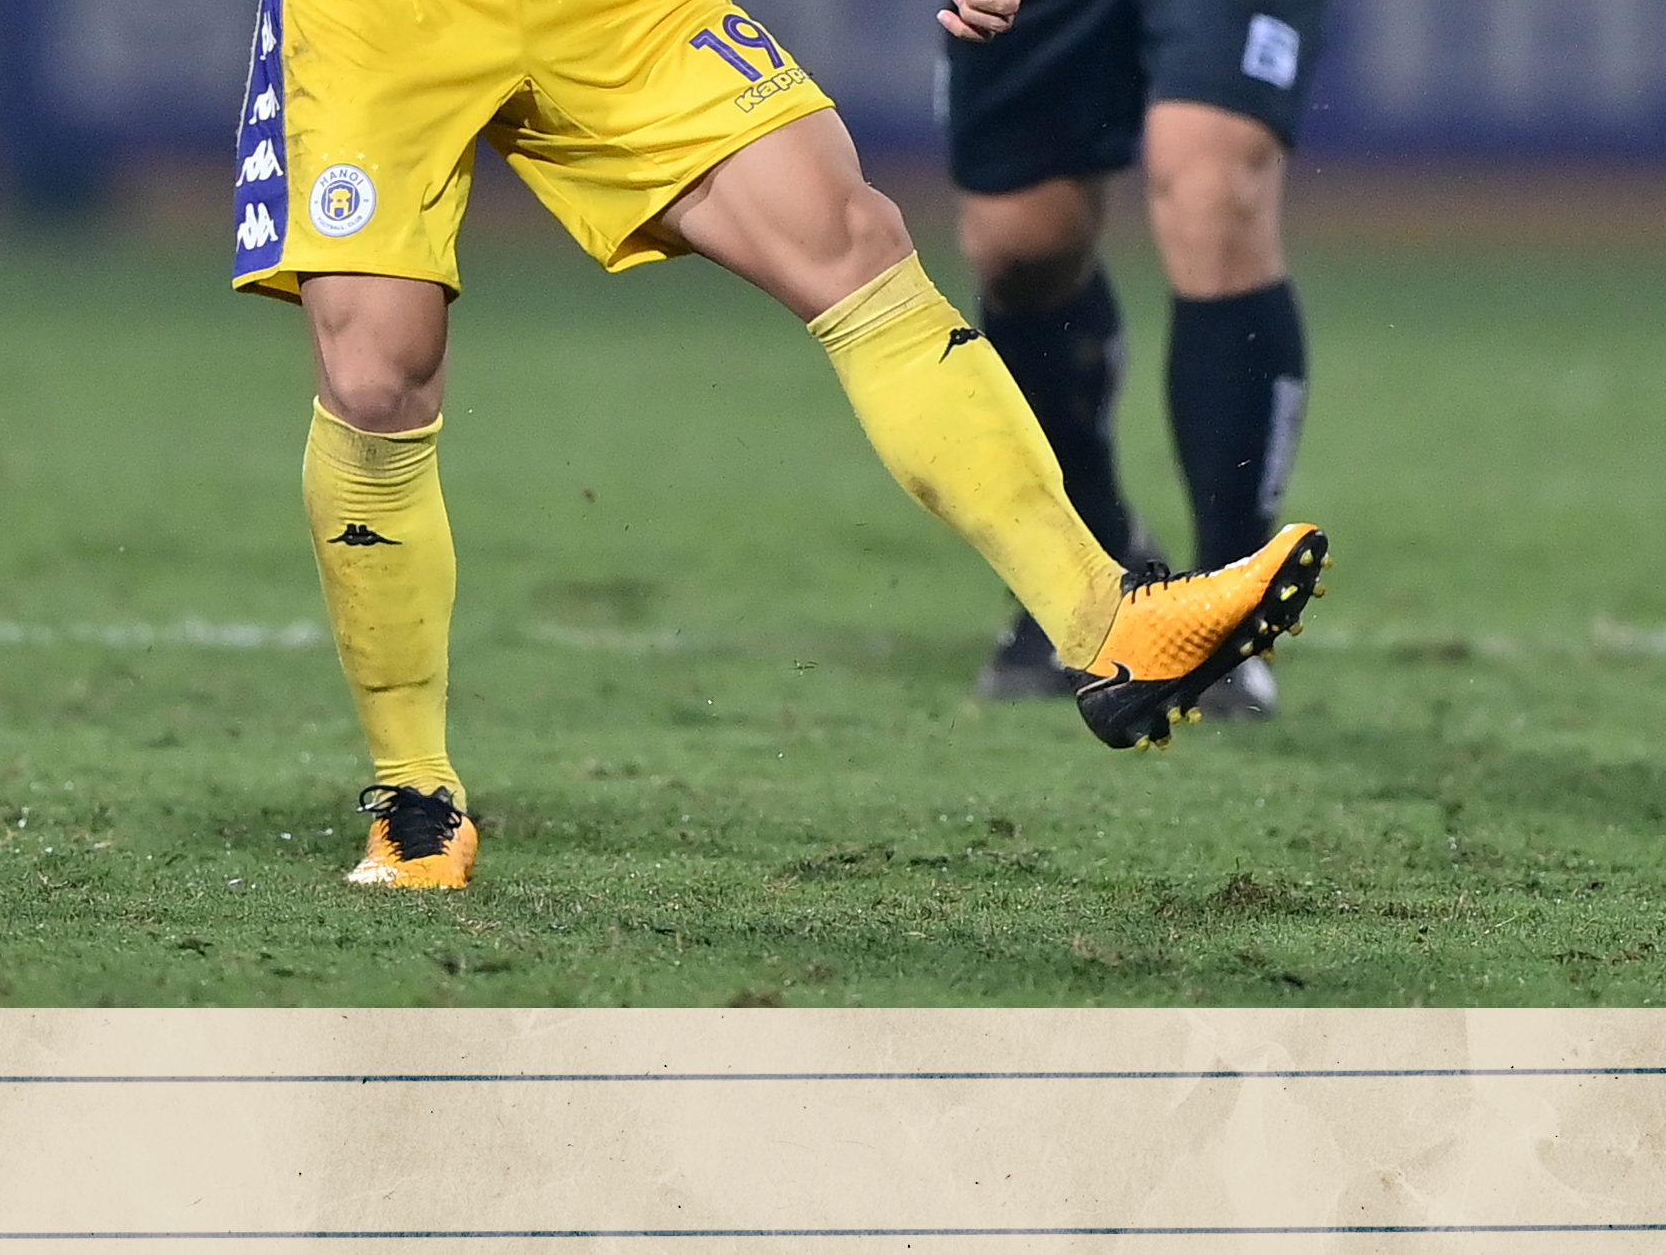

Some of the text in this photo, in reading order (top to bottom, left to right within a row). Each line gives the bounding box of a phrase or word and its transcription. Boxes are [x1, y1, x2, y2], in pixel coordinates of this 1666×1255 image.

[689, 14, 785, 82] 19
[734, 67, 808, 114] Kapp
[319, 169, 364, 188] HANOI
